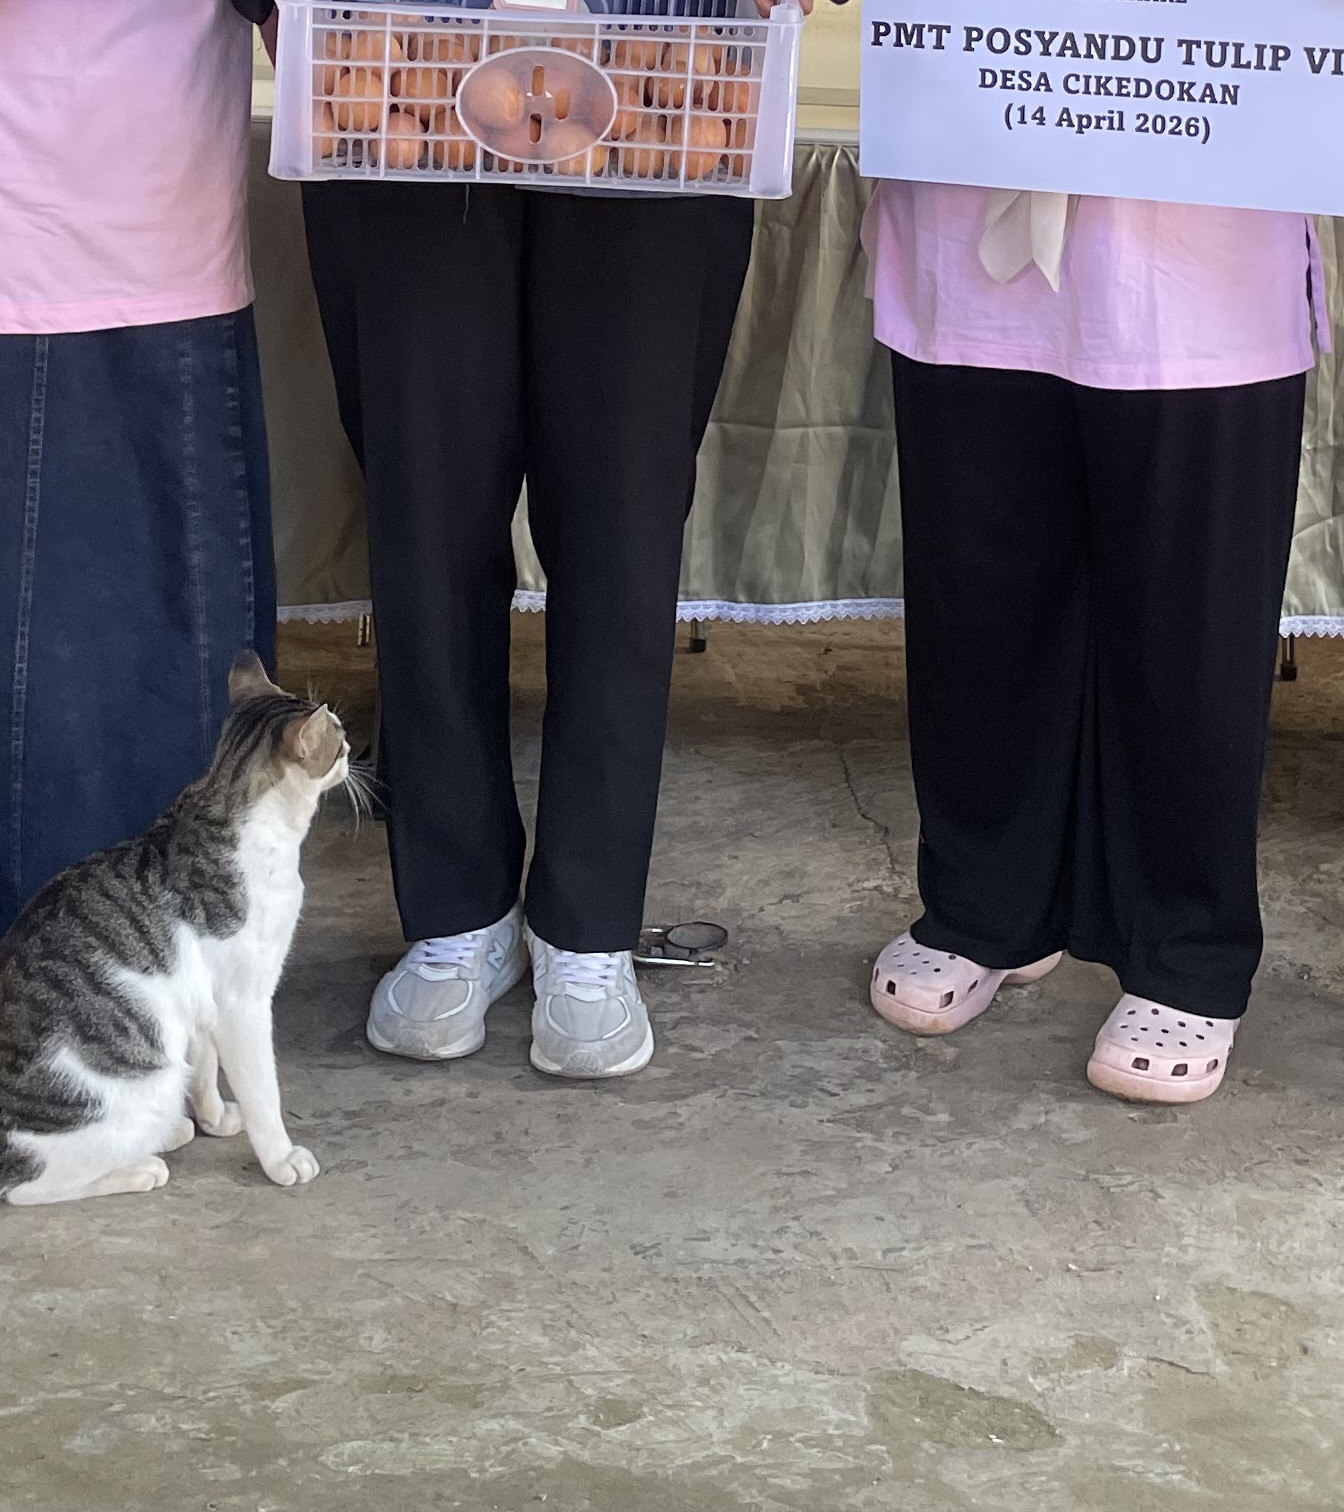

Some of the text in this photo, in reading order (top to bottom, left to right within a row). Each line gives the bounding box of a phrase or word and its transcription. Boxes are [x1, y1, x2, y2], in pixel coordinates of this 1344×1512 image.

[870, 20, 952, 50] PMT
[962, 25, 1165, 65] POSYANDU
[1177, 38, 1291, 74] TULIP
[978, 68, 1240, 106] DESA CIKEDOKAN
[1004, 102, 1212, 145] (14 April 2026)
